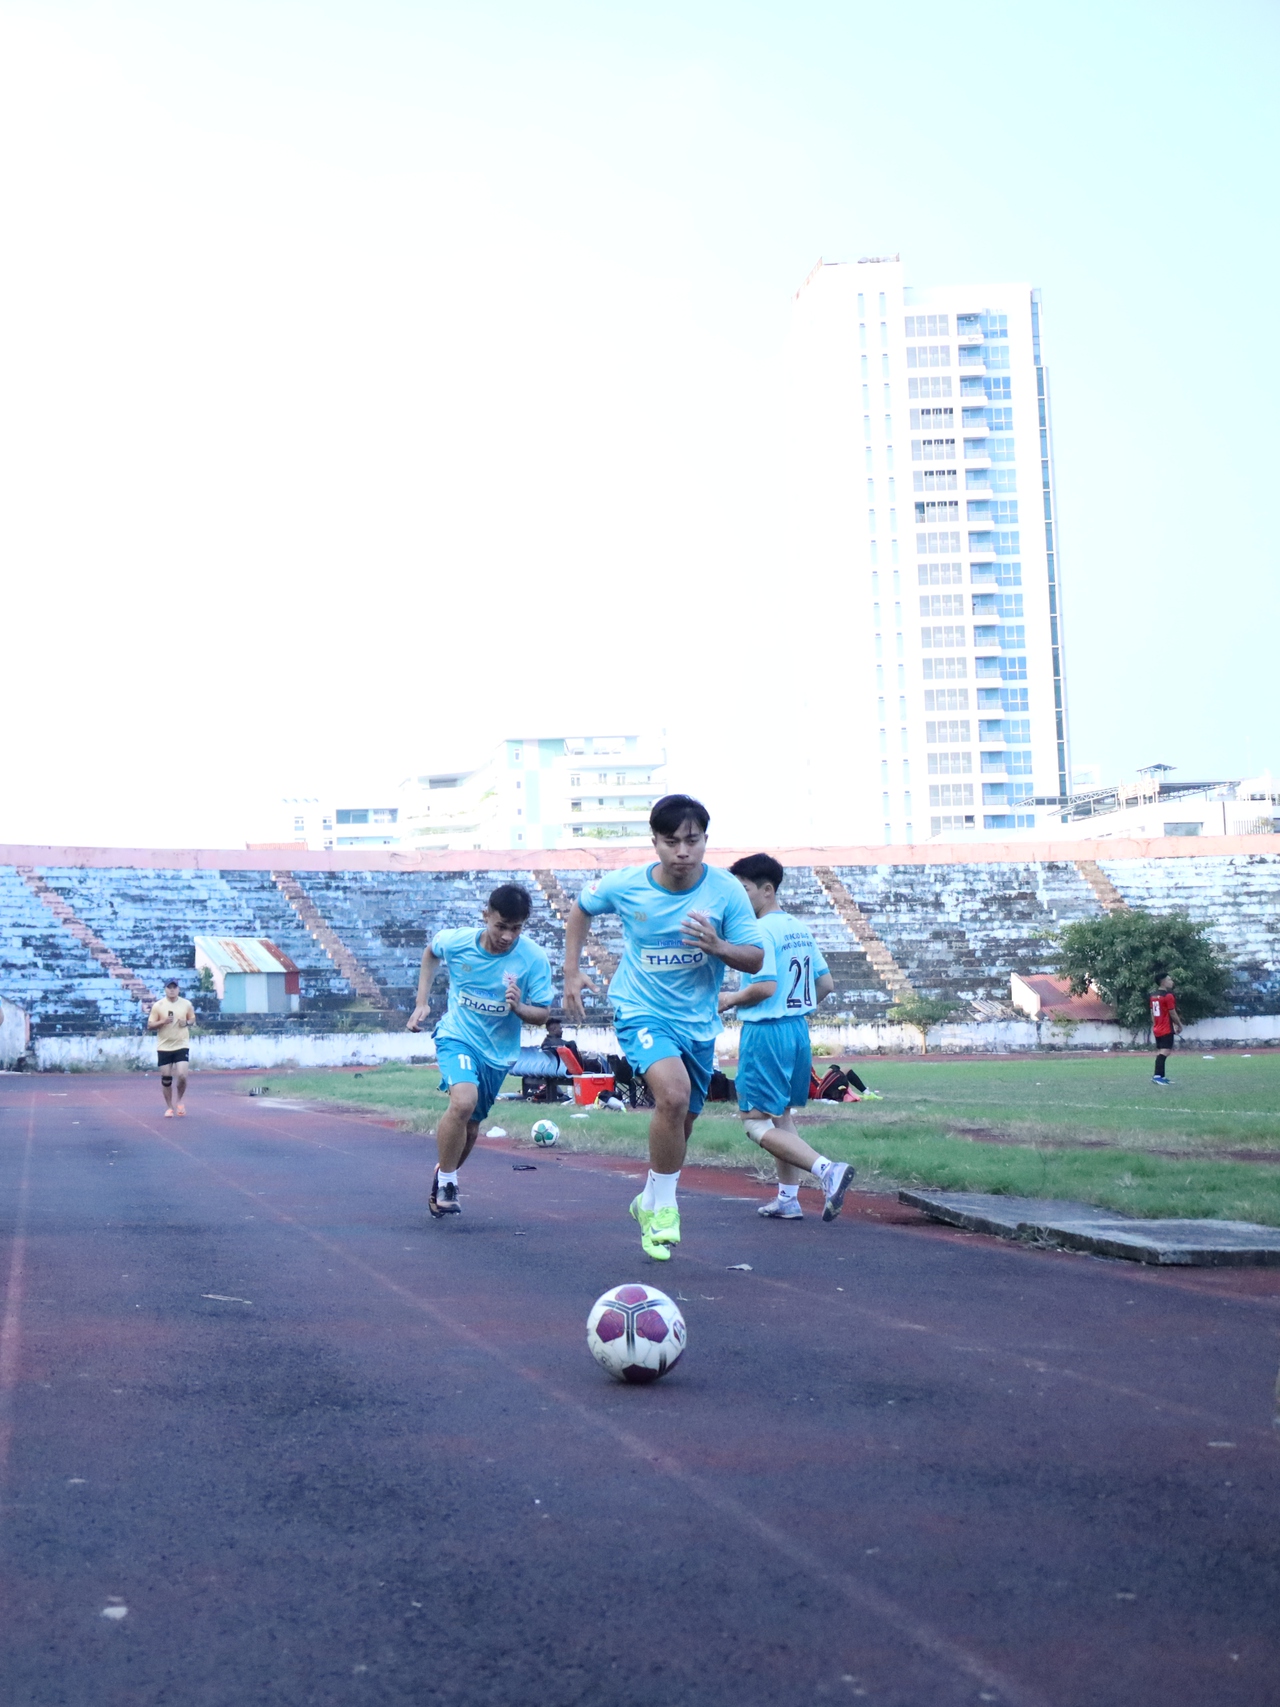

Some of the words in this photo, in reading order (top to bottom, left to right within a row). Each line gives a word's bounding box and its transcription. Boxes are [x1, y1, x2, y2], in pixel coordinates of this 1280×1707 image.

[646, 952, 703, 966] THACO
[787, 955, 812, 1009] 21
[462, 997, 506, 1013] THACO
[637, 1027, 654, 1050] 5
[458, 1054, 472, 1070] 11
